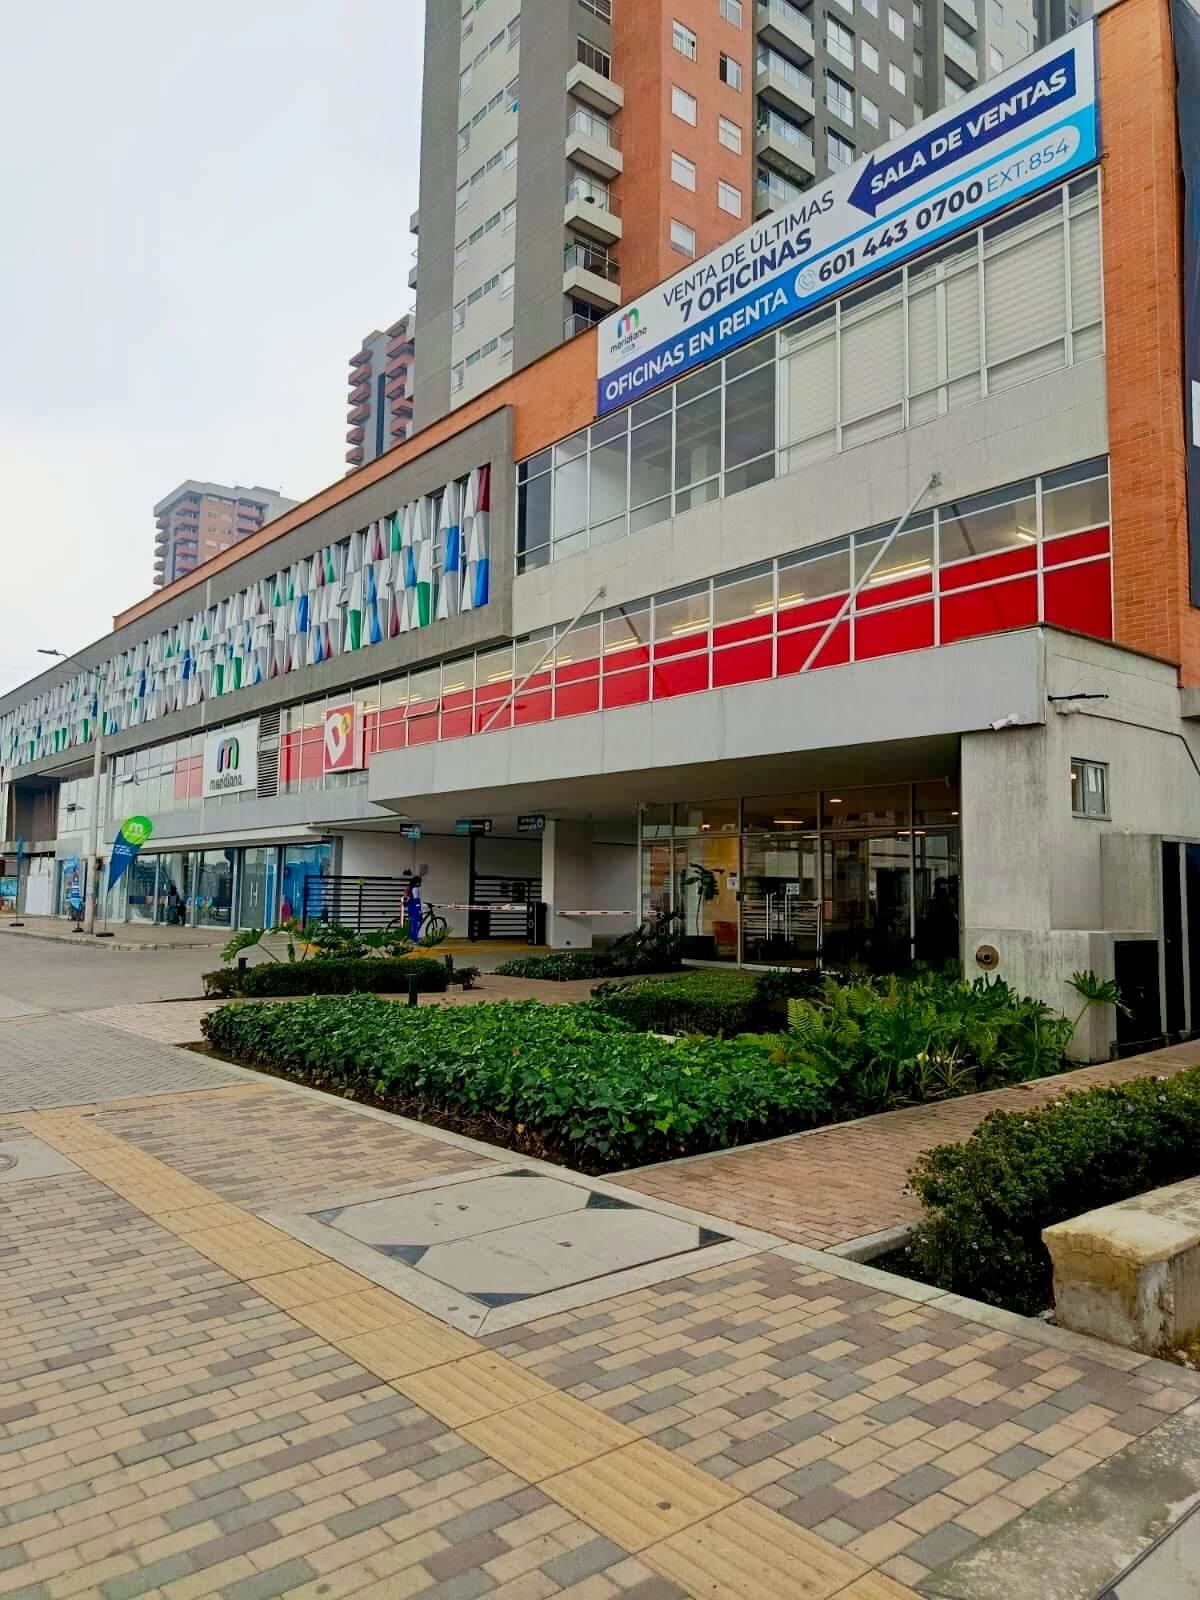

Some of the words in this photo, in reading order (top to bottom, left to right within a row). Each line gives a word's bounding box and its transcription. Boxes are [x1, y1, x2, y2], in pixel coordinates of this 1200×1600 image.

[871, 151, 927, 195] SALA
[931, 128, 963, 160] DE
[966, 68, 1067, 138] VENTAS
[663, 264, 717, 307] VENTA
[721, 244, 746, 273] DE
[750, 190, 834, 254] ÚLTIMAS
[680, 300, 693, 323] 7
[698, 228, 812, 312] OFICINAS
[819, 248, 856, 282] 601
[862, 220, 908, 258] 443
[916, 181, 983, 230] 0700
[606, 343, 685, 400] OFICINAS
[689, 326, 715, 352] EN
[720, 287, 788, 340] RENTA
[610, 327, 647, 353] meridiano
[209, 773, 243, 791] meridiano
